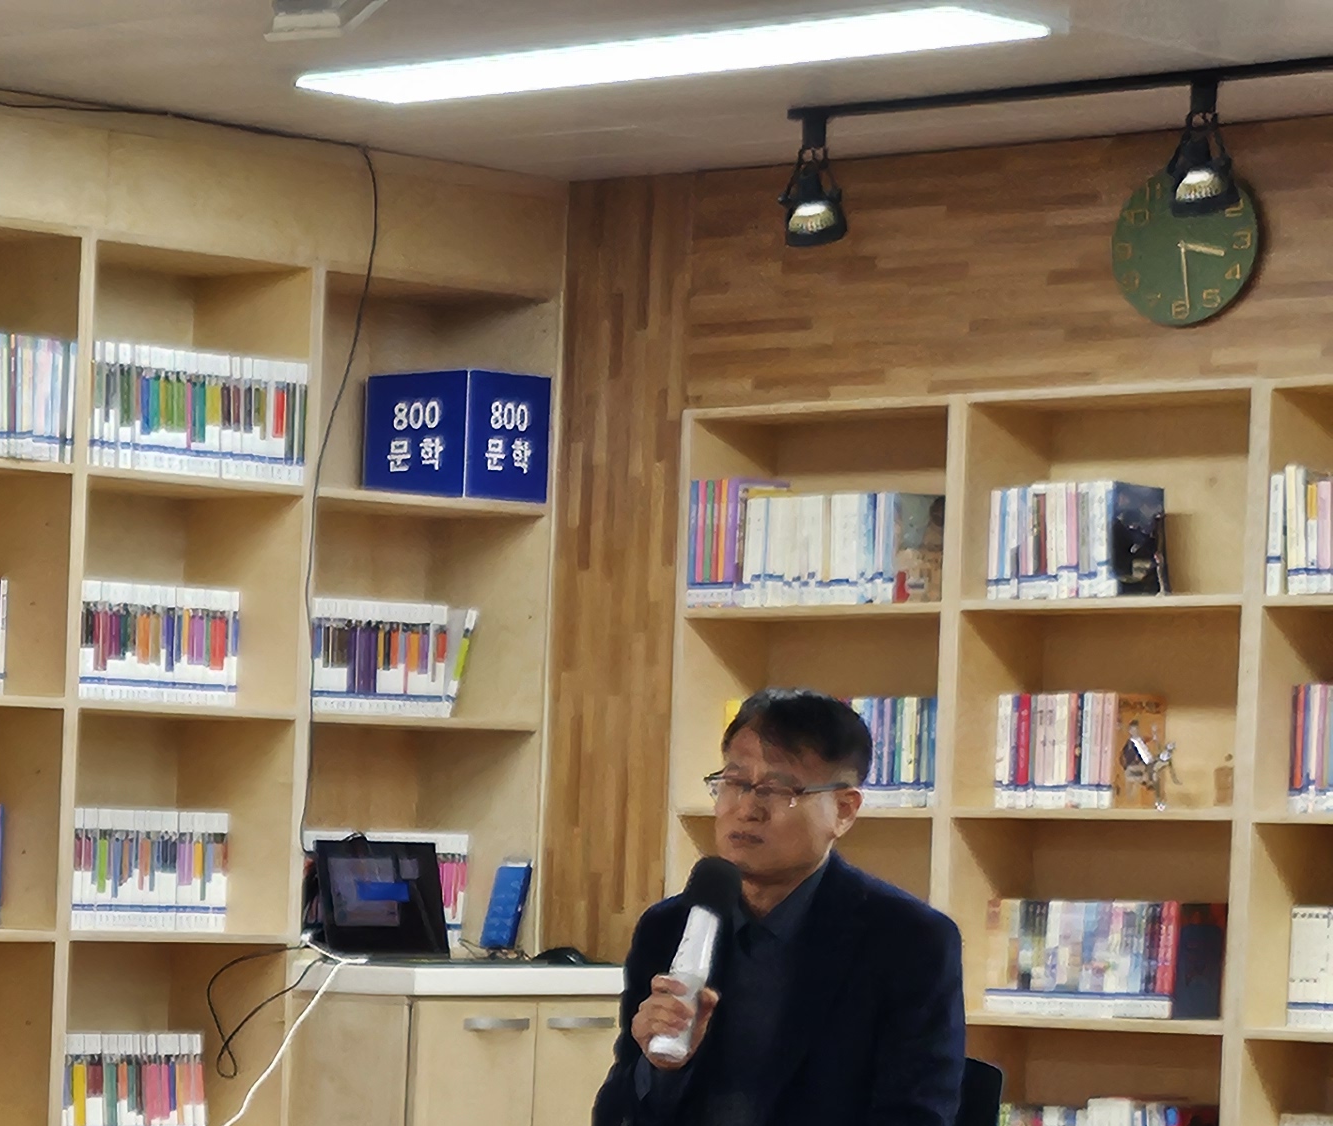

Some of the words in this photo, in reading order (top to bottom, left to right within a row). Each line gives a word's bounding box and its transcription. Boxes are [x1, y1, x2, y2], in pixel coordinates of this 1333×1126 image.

[1232, 229, 1252, 250] 3
[1224, 263, 1241, 280] 4
[1202, 288, 1222, 308] 5
[393, 400, 441, 431] 800
[490, 400, 529, 432] 800
[386, 437, 444, 473] 문학
[485, 437, 532, 474] 문학
